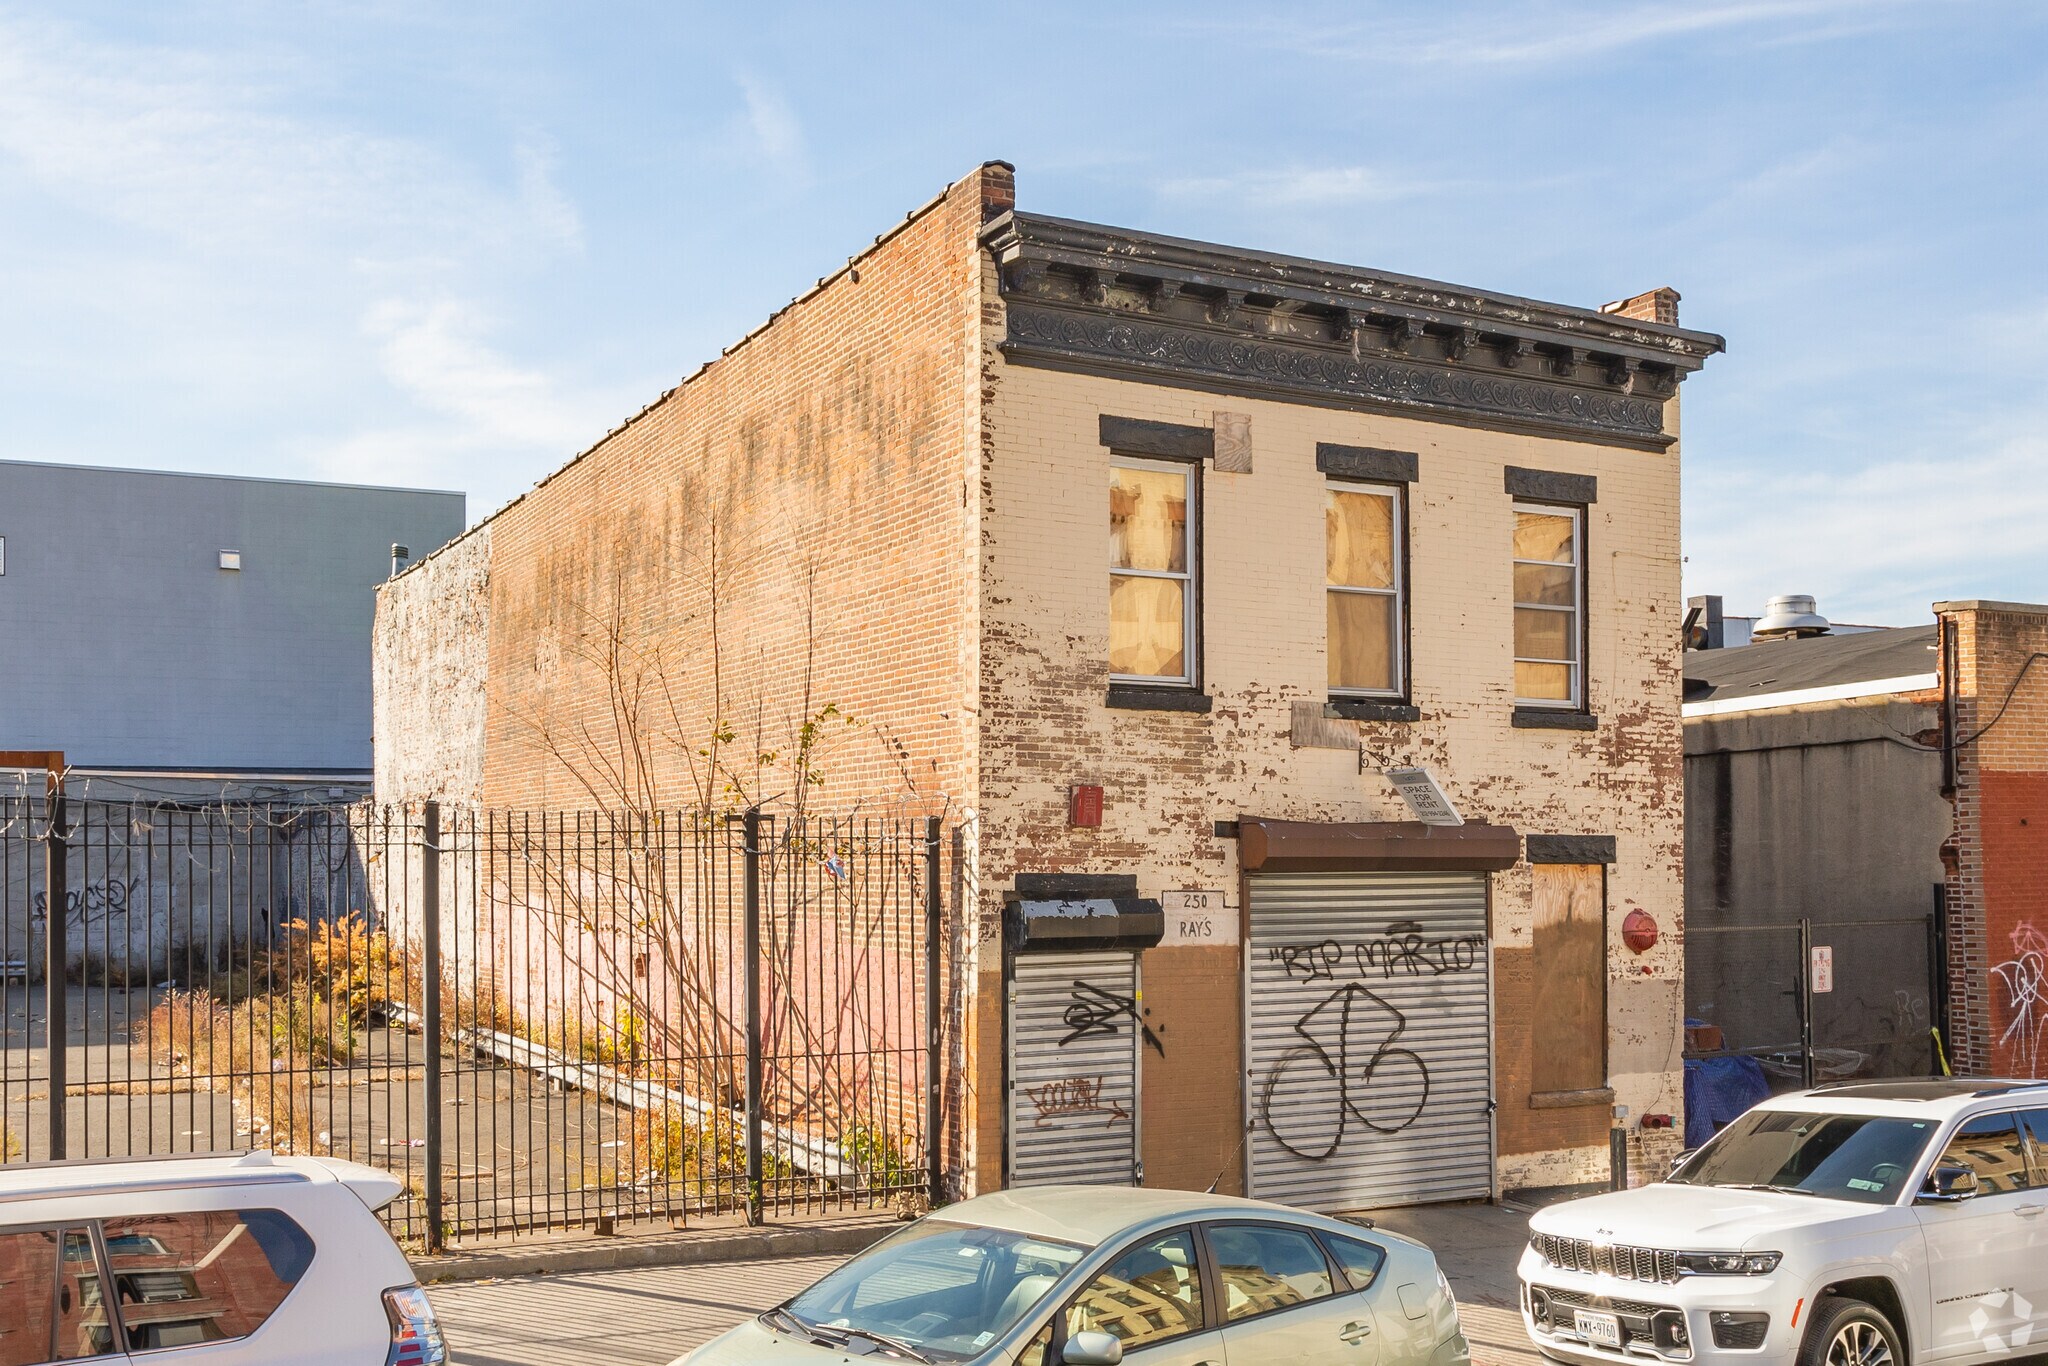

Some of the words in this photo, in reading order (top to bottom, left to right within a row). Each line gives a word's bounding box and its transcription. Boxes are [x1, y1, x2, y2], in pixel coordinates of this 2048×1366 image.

[1403, 785, 1432, 794] SPACE
[1416, 801, 1440, 809] RENT
[1184, 894, 1208, 909] 250
[1180, 917, 1212, 937] RAY'S
